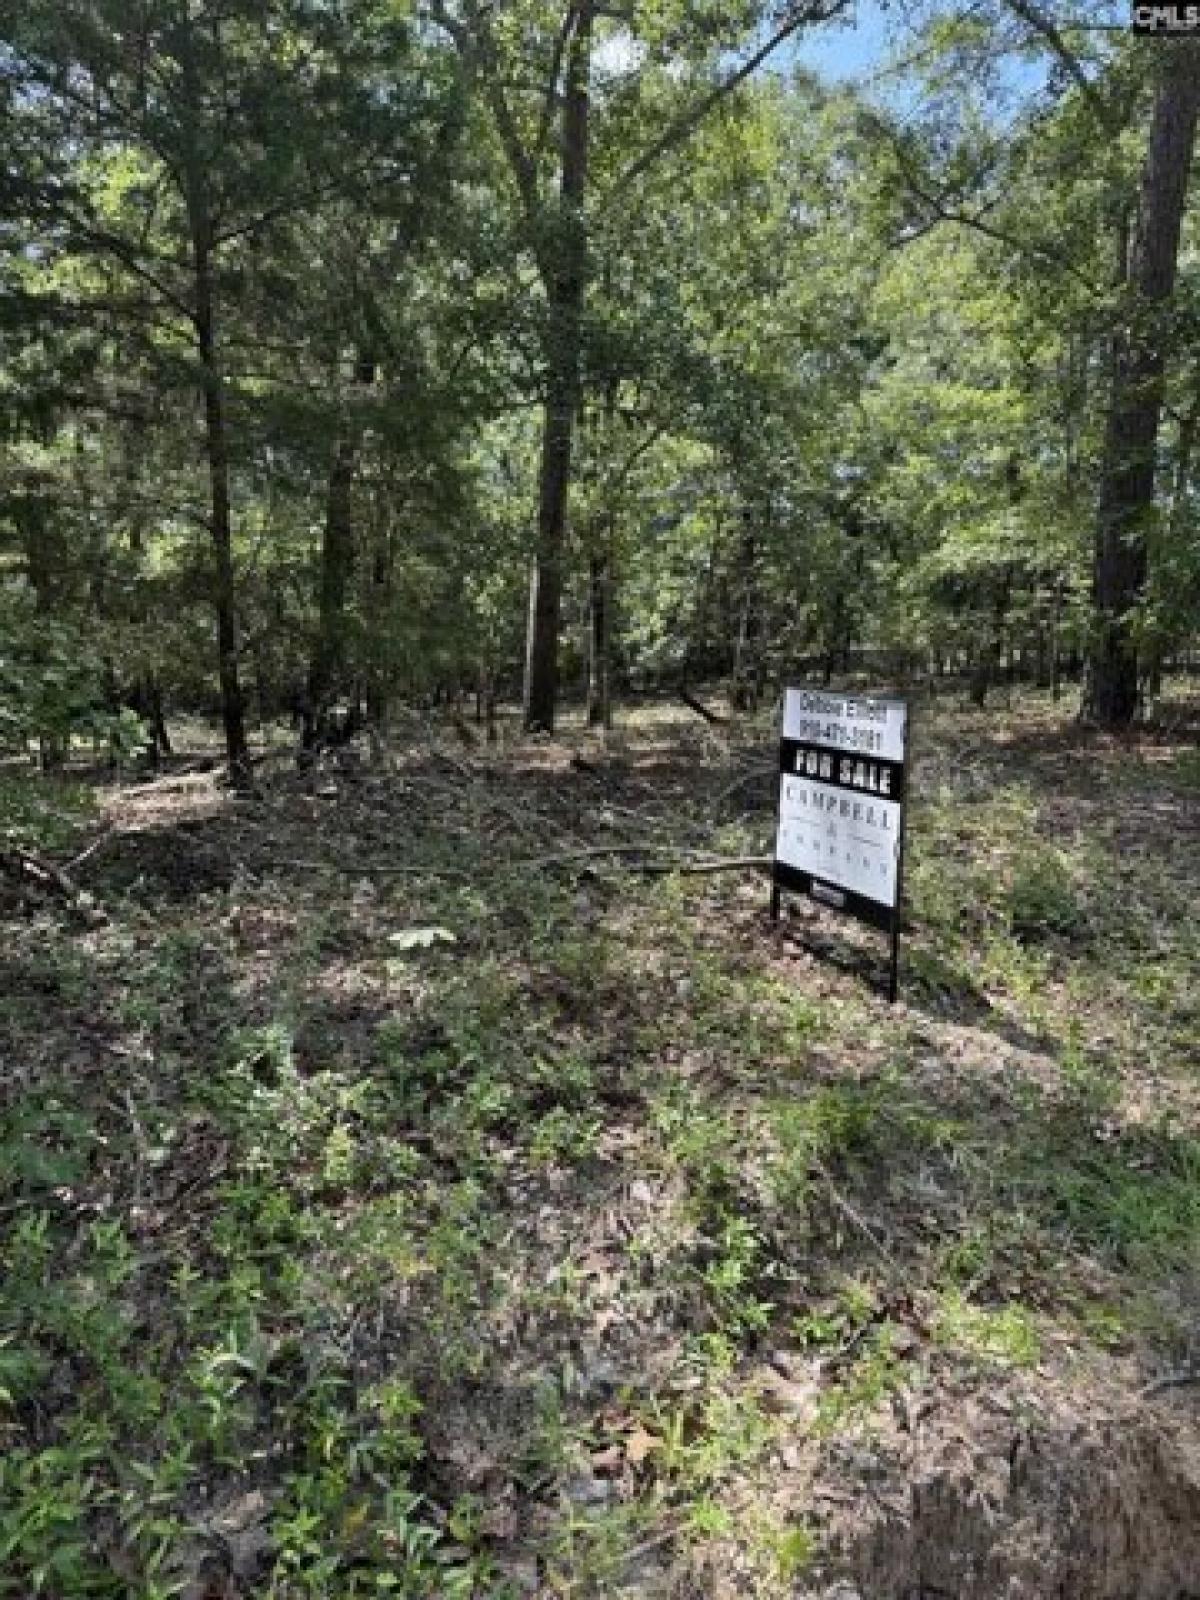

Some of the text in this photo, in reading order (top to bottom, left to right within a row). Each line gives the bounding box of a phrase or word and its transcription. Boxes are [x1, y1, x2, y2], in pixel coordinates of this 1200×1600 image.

[795, 749, 891, 794] FOR SALE
[785, 785, 890, 831] CAMPBELL
